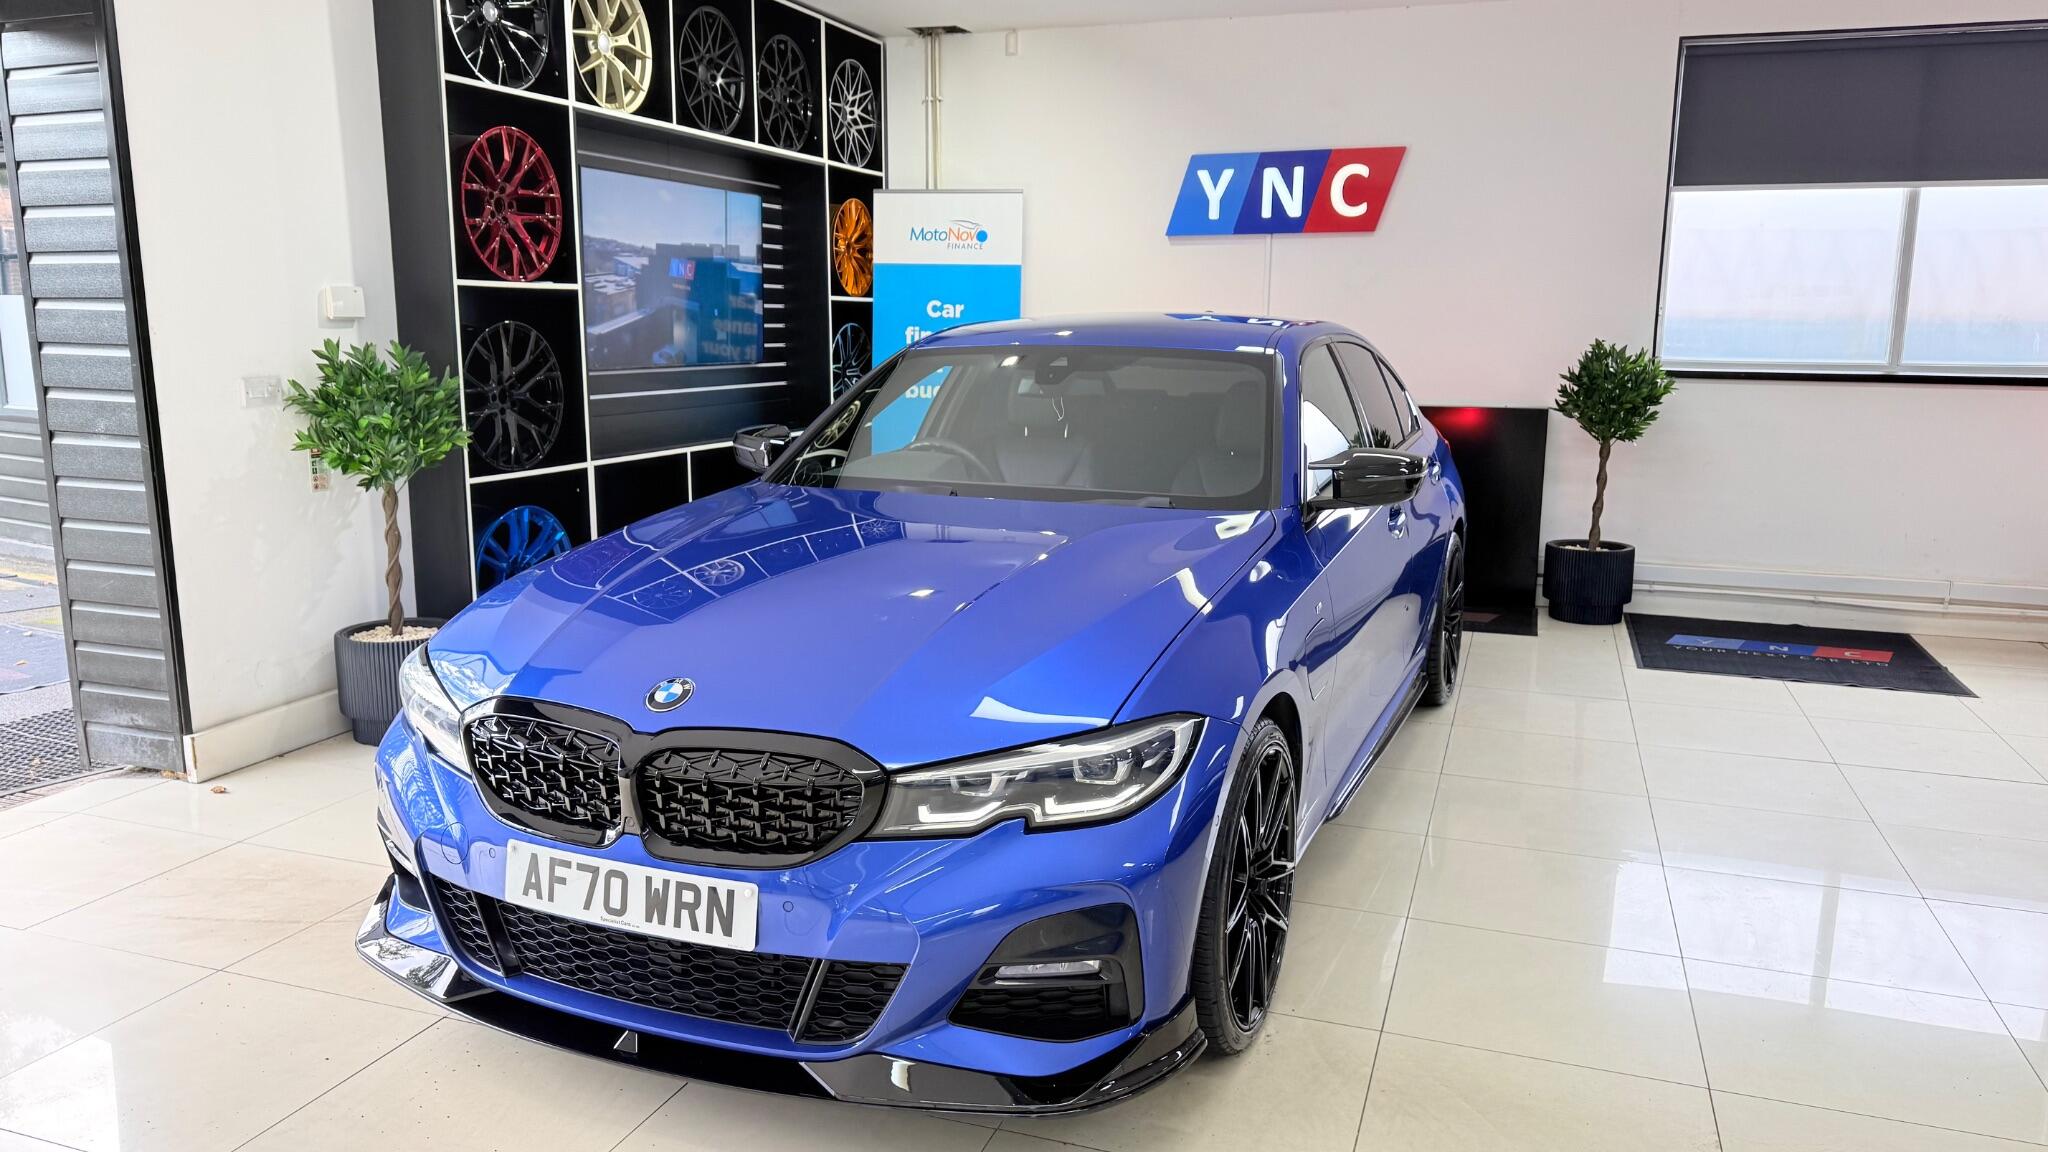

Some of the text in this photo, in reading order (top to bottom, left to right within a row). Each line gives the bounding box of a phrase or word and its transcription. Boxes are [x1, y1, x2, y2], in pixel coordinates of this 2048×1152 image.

[1196, 162, 1371, 221] YNC
[946, 242, 984, 250] FINANCE
[926, 299, 965, 318] Car
[1737, 650, 1788, 659] NEXT
[1799, 655, 1839, 663] CAR
[1850, 659, 1889, 667] LTD
[522, 852, 736, 938] AF70 WRN
